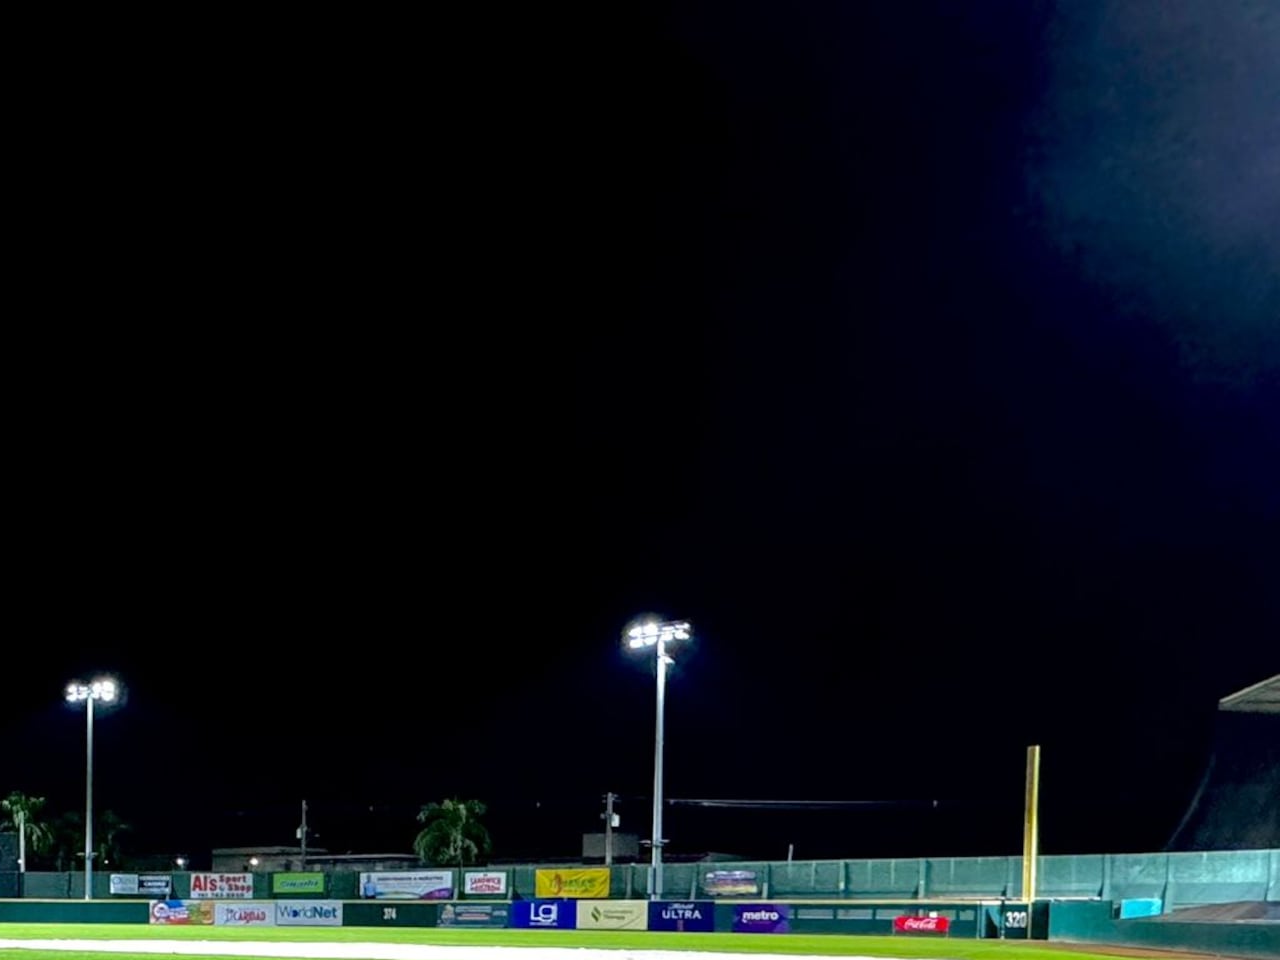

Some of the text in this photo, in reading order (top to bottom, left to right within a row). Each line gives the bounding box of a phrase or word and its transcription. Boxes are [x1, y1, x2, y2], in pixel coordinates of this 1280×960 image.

[192, 875, 246, 892] Al's Sport
[227, 883, 251, 893] Shop
[279, 905, 337, 918] WorldNet
[662, 910, 702, 919] ULTRA
[742, 910, 779, 921] metro
[1005, 911, 1027, 928] 320
